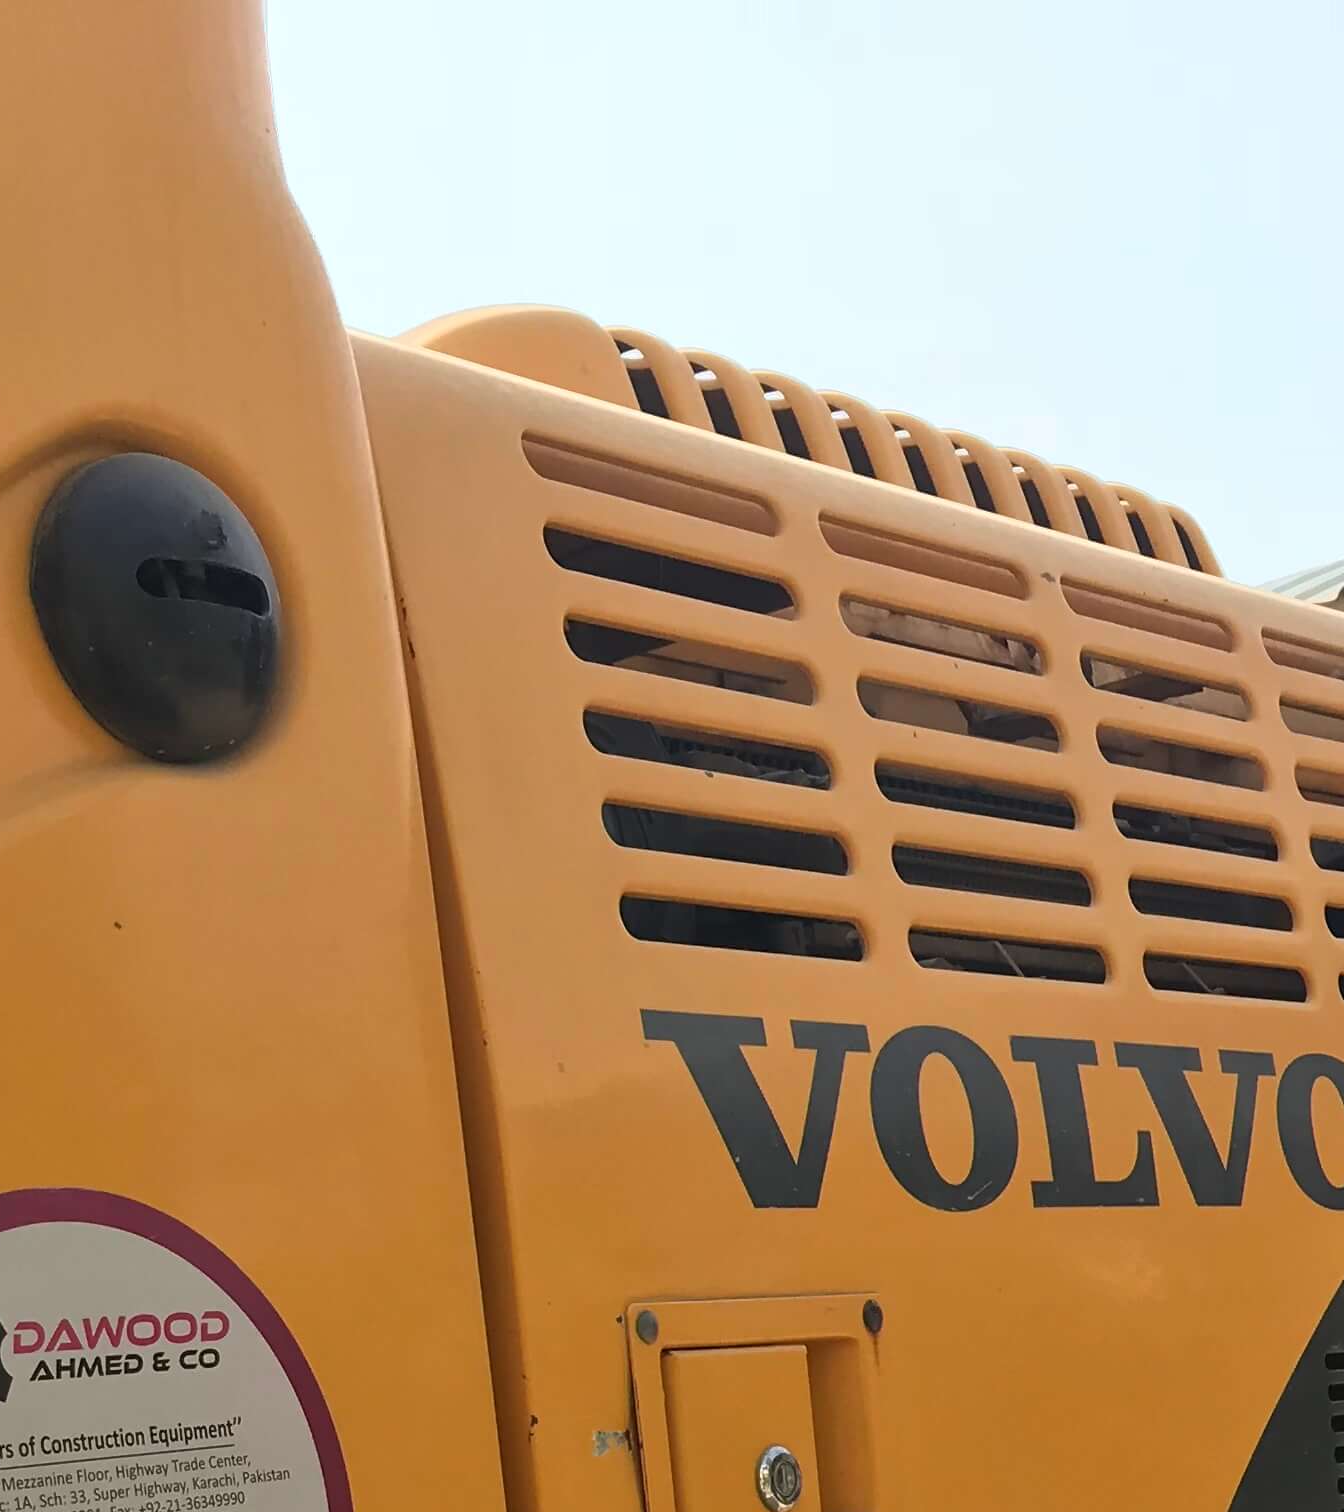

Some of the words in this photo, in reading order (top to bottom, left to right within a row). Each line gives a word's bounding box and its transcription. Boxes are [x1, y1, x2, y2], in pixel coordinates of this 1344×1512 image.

[12, 1310, 230, 1355] DAWOOD
[29, 1353, 144, 1382] AHMED
[152, 1352, 171, 1372] &
[179, 1348, 221, 1370] CO
[19, 1436, 36, 1456] of
[40, 1426, 145, 1455] Construction
[2, 1472, 73, 1491] Mezzanine
[77, 1467, 113, 1484] Floor,
[116, 1461, 169, 1481] Highway
[172, 1457, 205, 1473] Trade
[209, 1453, 251, 1469] Center,
[14, 1495, 36, 1512] 1A,
[39, 1492, 67, 1508] Sch:
[70, 1490, 91, 1505] 33,
[94, 1486, 130, 1503] Super
[134, 1480, 189, 1500] Highway,
[193, 1473, 240, 1491] Karachi,
[243, 1467, 290, 1485] Pakistan
